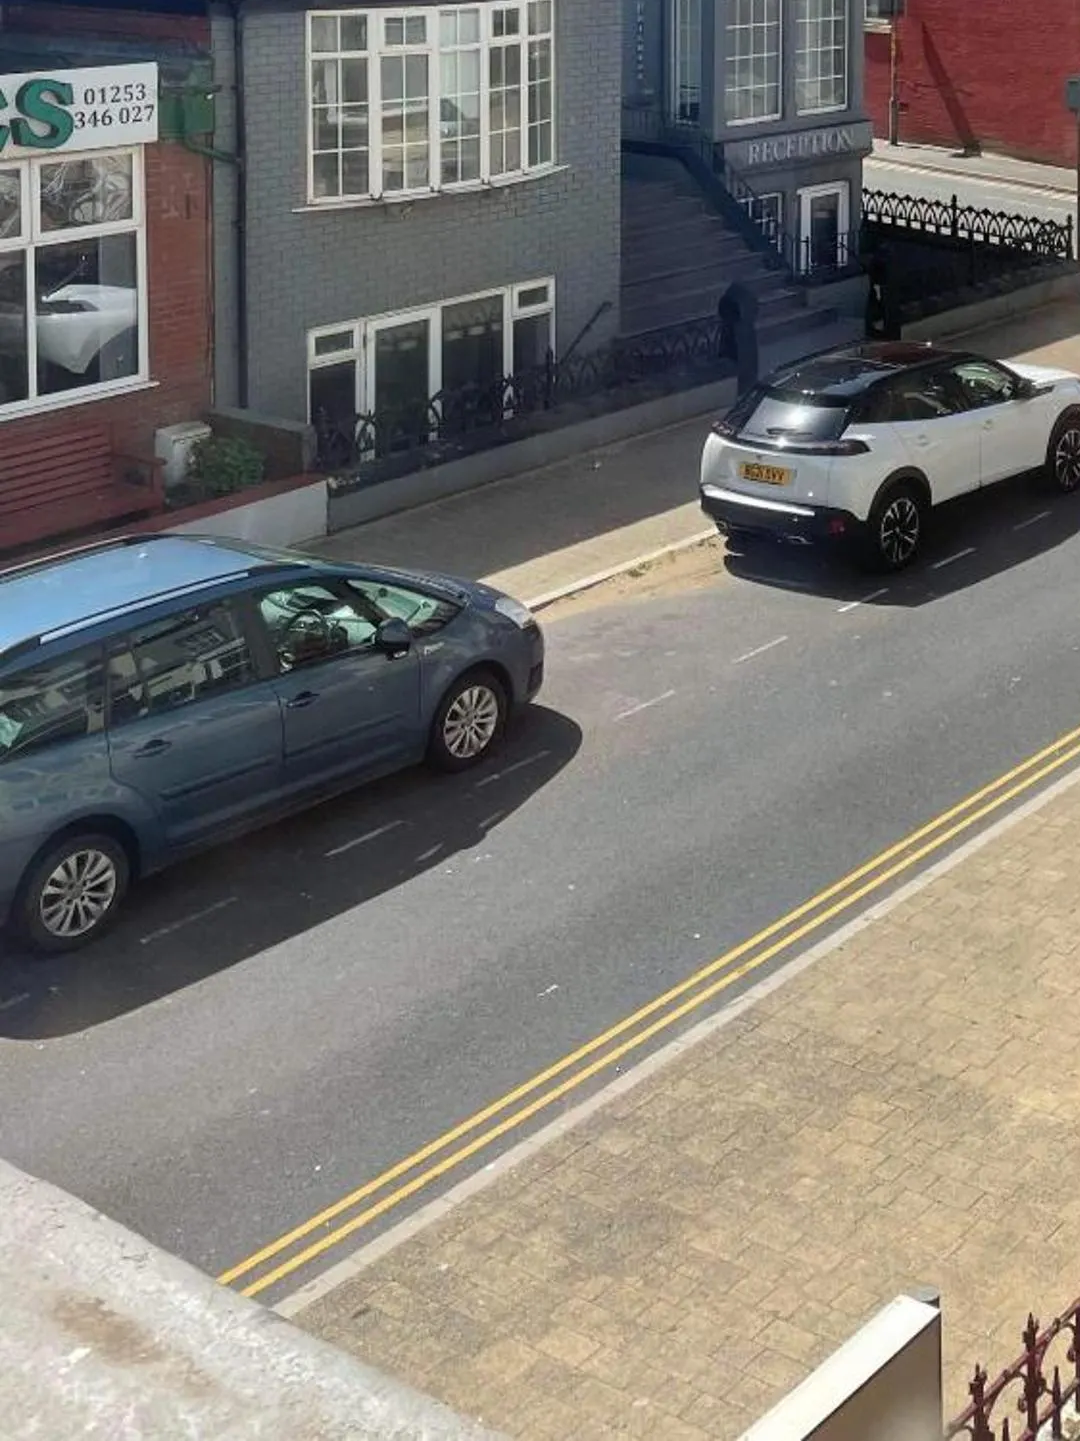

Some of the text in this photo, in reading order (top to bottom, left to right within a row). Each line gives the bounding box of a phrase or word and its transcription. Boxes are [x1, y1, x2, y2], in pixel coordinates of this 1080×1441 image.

[83, 83, 147, 106] 01253
[0, 79, 74, 152] S
[74, 104, 155, 129] 346 027
[748, 127, 855, 165] RECEPTION
